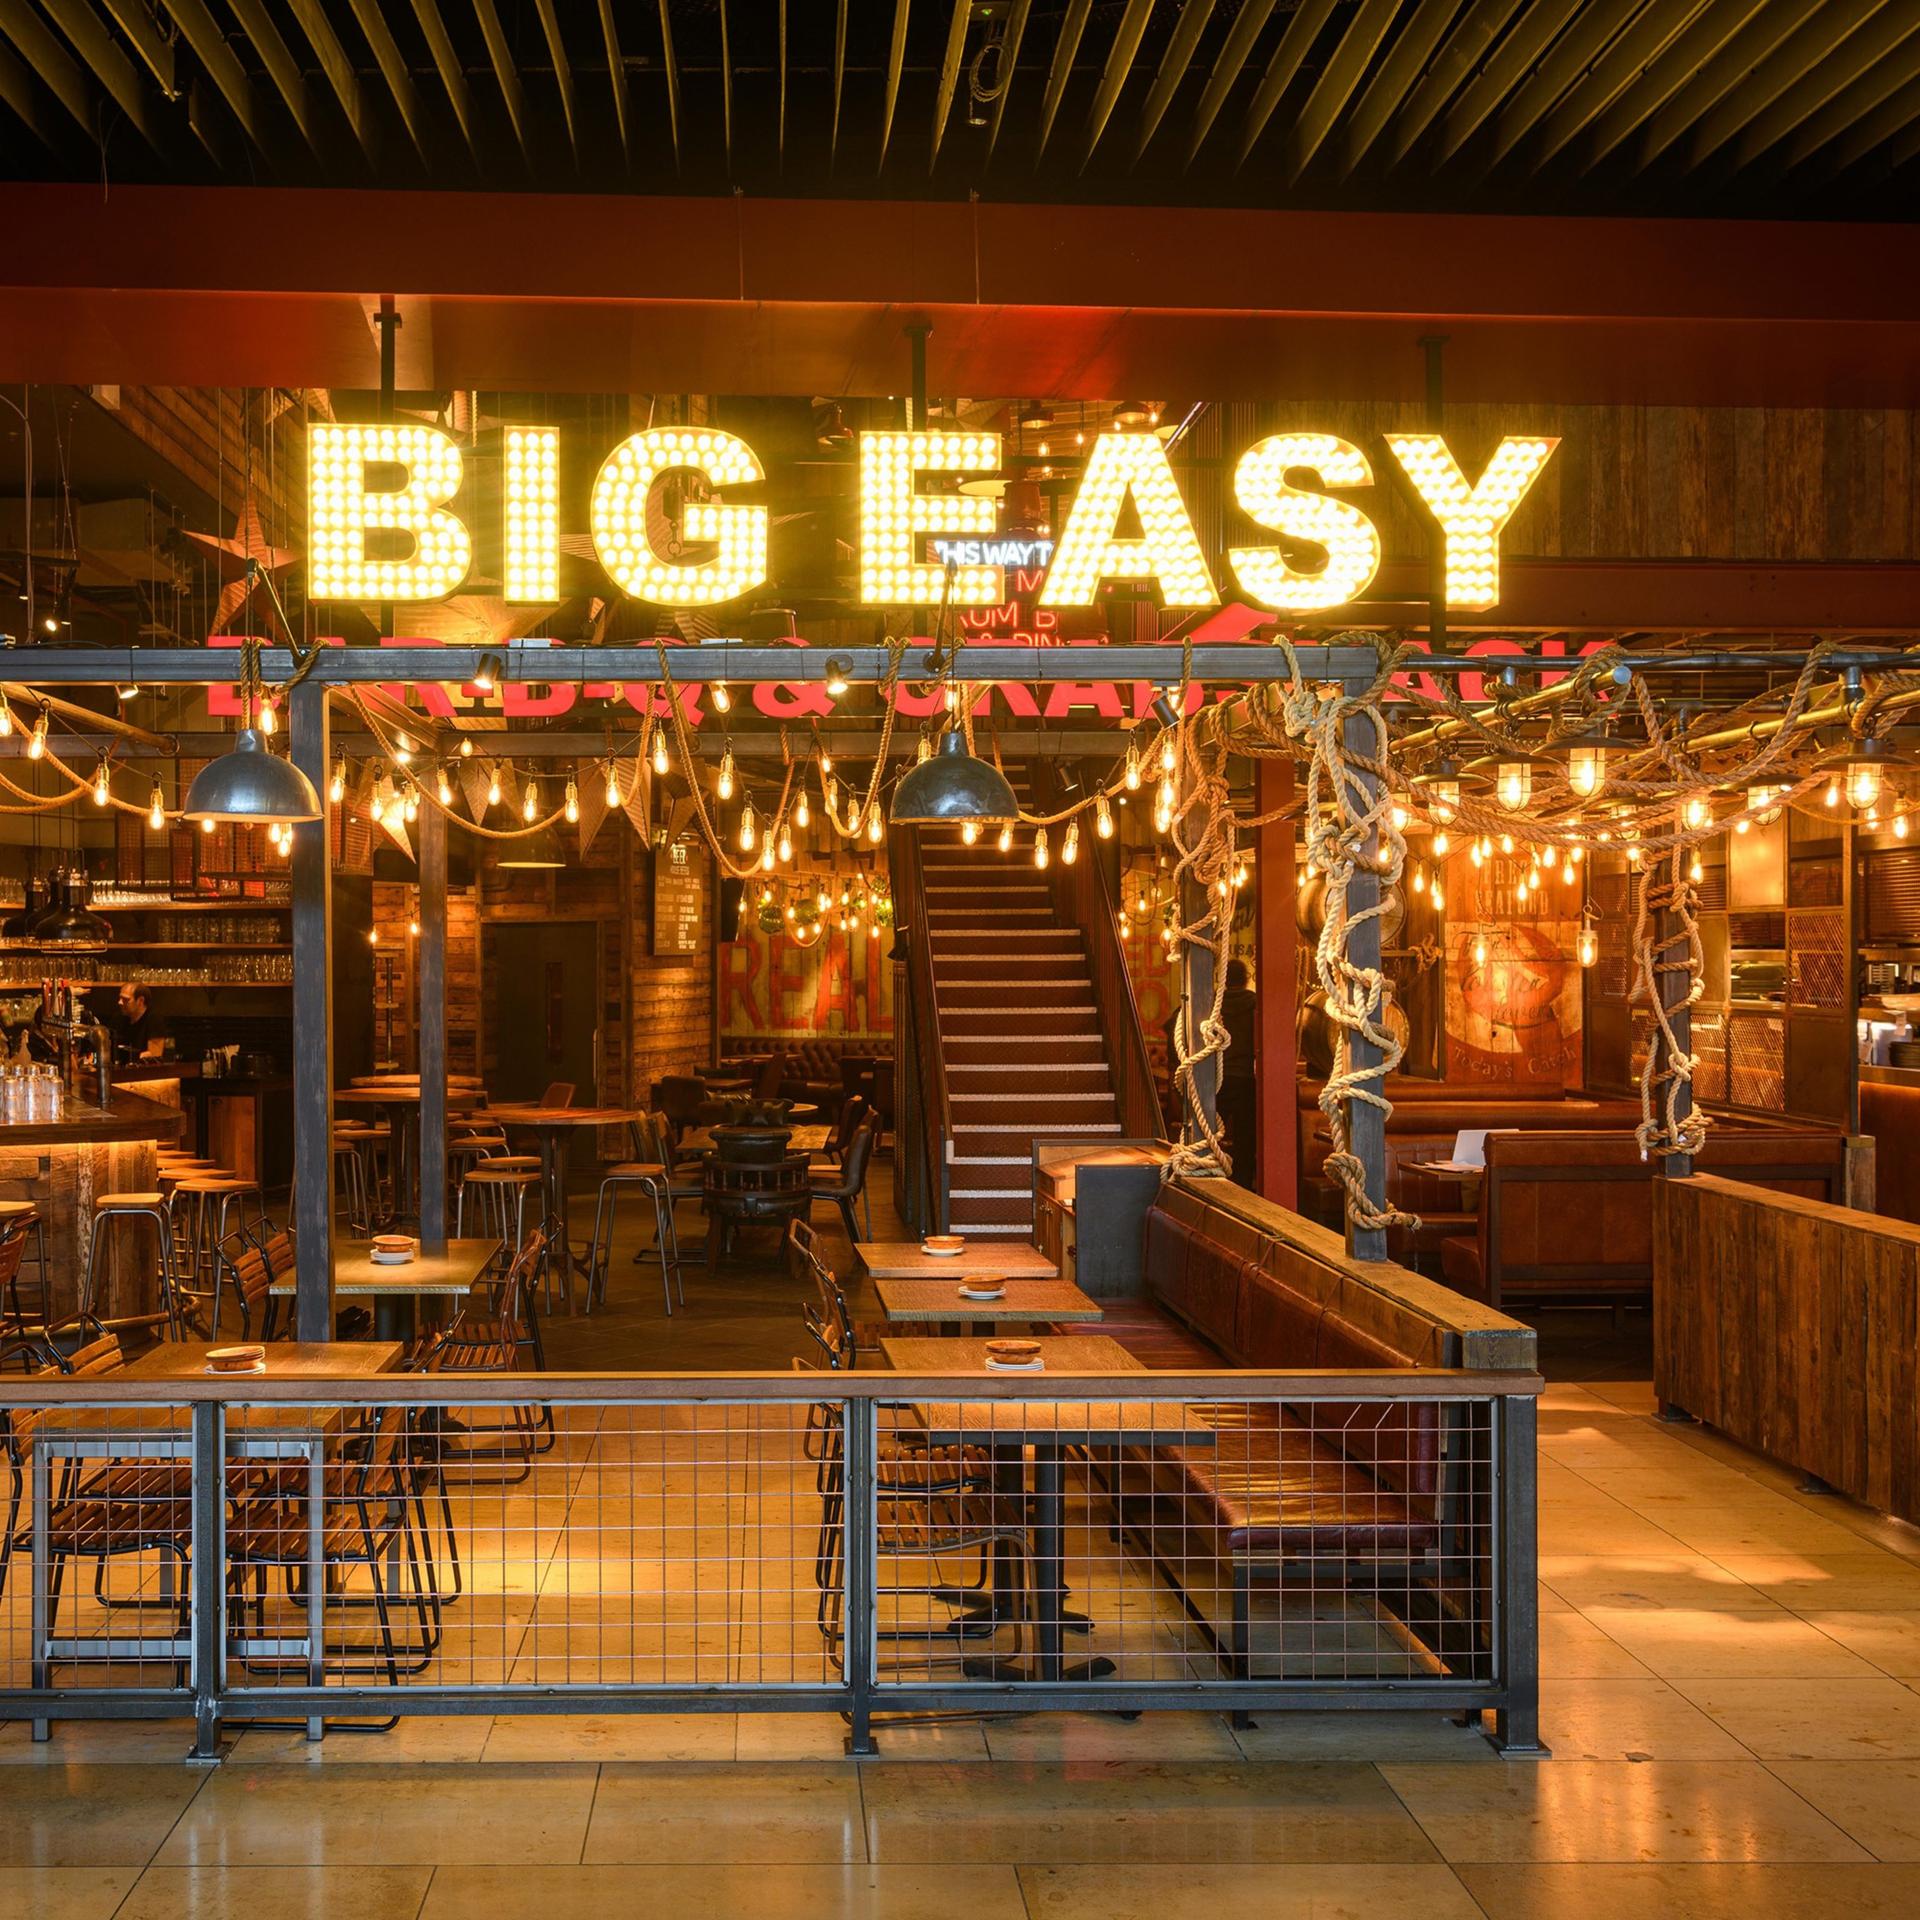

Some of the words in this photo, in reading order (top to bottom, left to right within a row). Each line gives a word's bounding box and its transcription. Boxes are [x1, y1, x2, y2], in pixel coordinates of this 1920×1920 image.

[307, 422, 769, 606] BIG
[860, 431, 1562, 611] EASY
[982, 542, 1034, 566] WAY
[718, 933, 894, 1032] REAL
[1454, 1046, 1513, 1080] Today's
